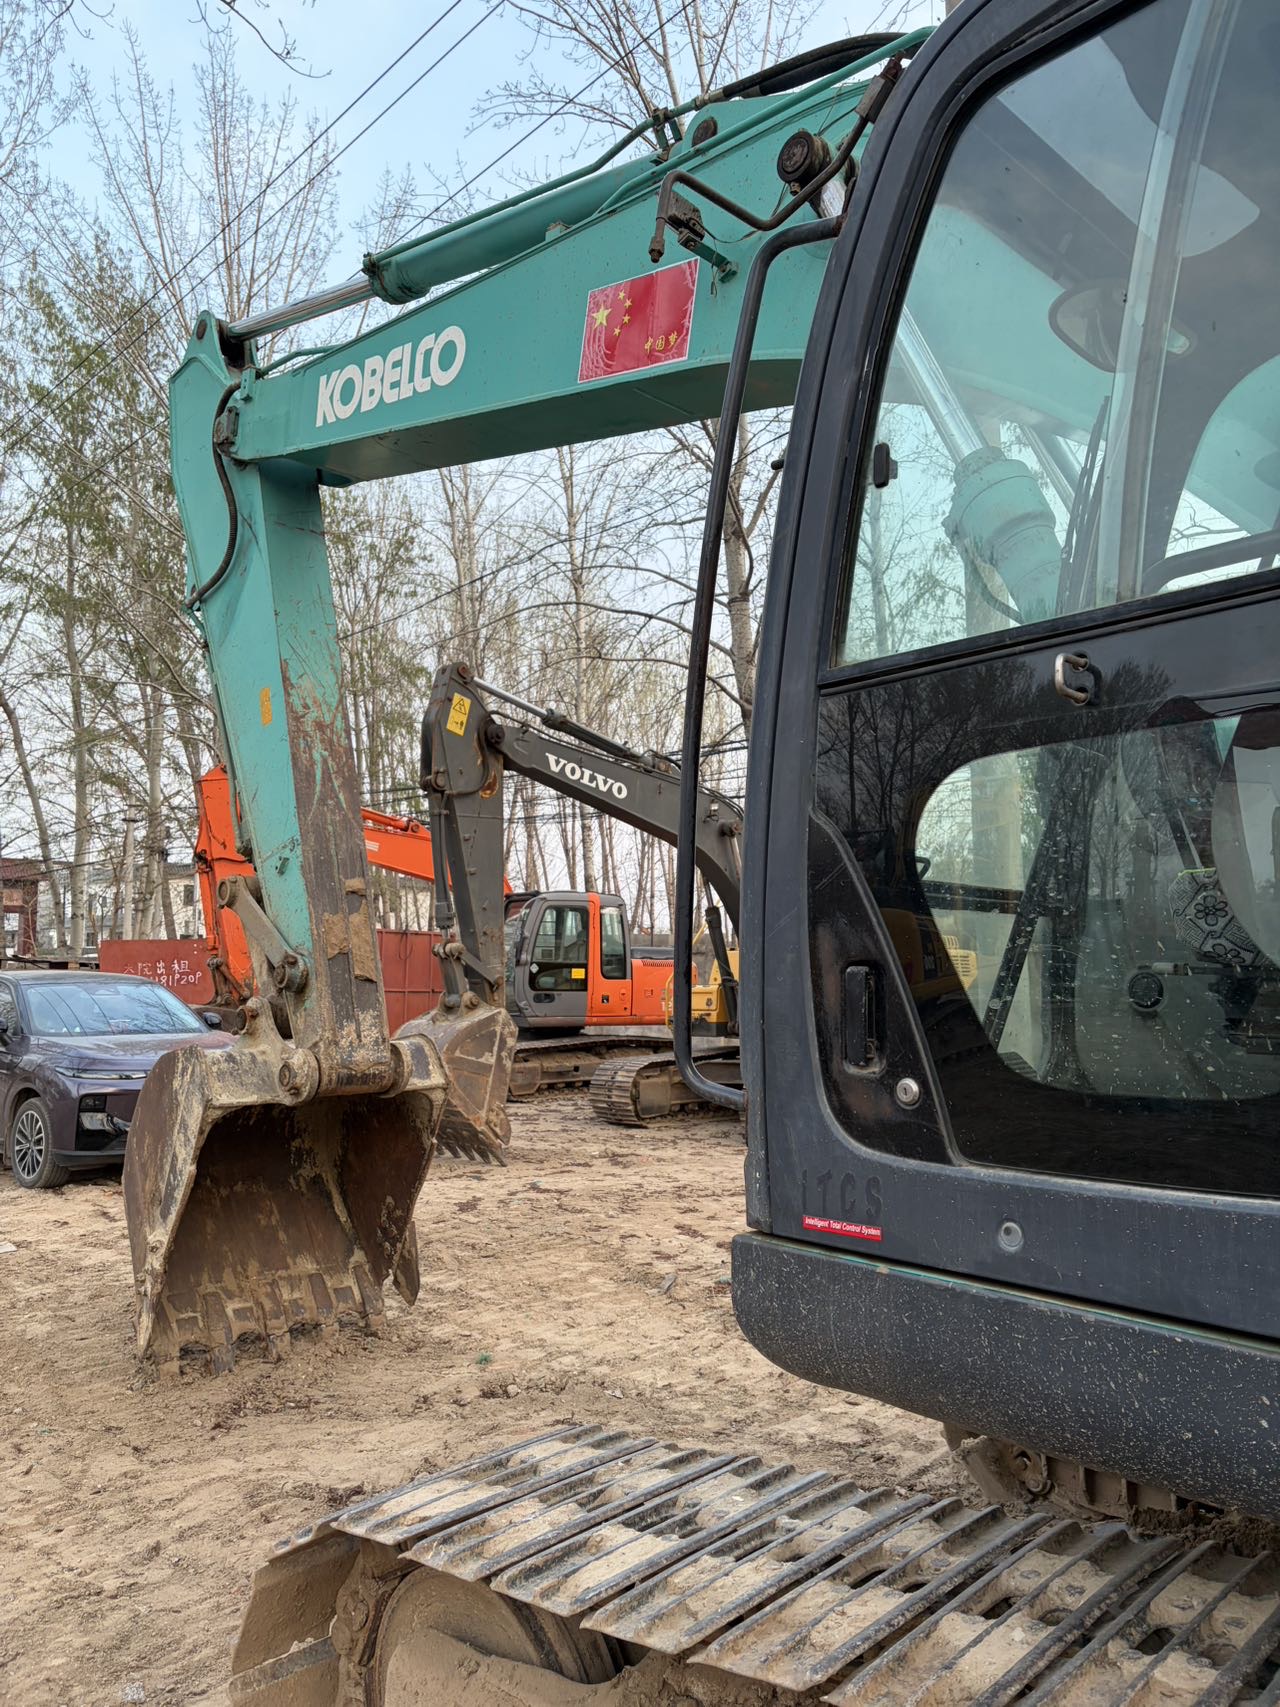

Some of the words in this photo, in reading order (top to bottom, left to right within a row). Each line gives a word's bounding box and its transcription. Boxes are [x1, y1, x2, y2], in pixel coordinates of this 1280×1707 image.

[315, 325, 467, 428] KOBELCO
[545, 752, 628, 799] VOLVO
[805, 1216, 829, 1228] Intelligent
[829, 1220, 842, 1230] Total
[842, 1222, 861, 1233] Control
[861, 1225, 881, 1236] System
